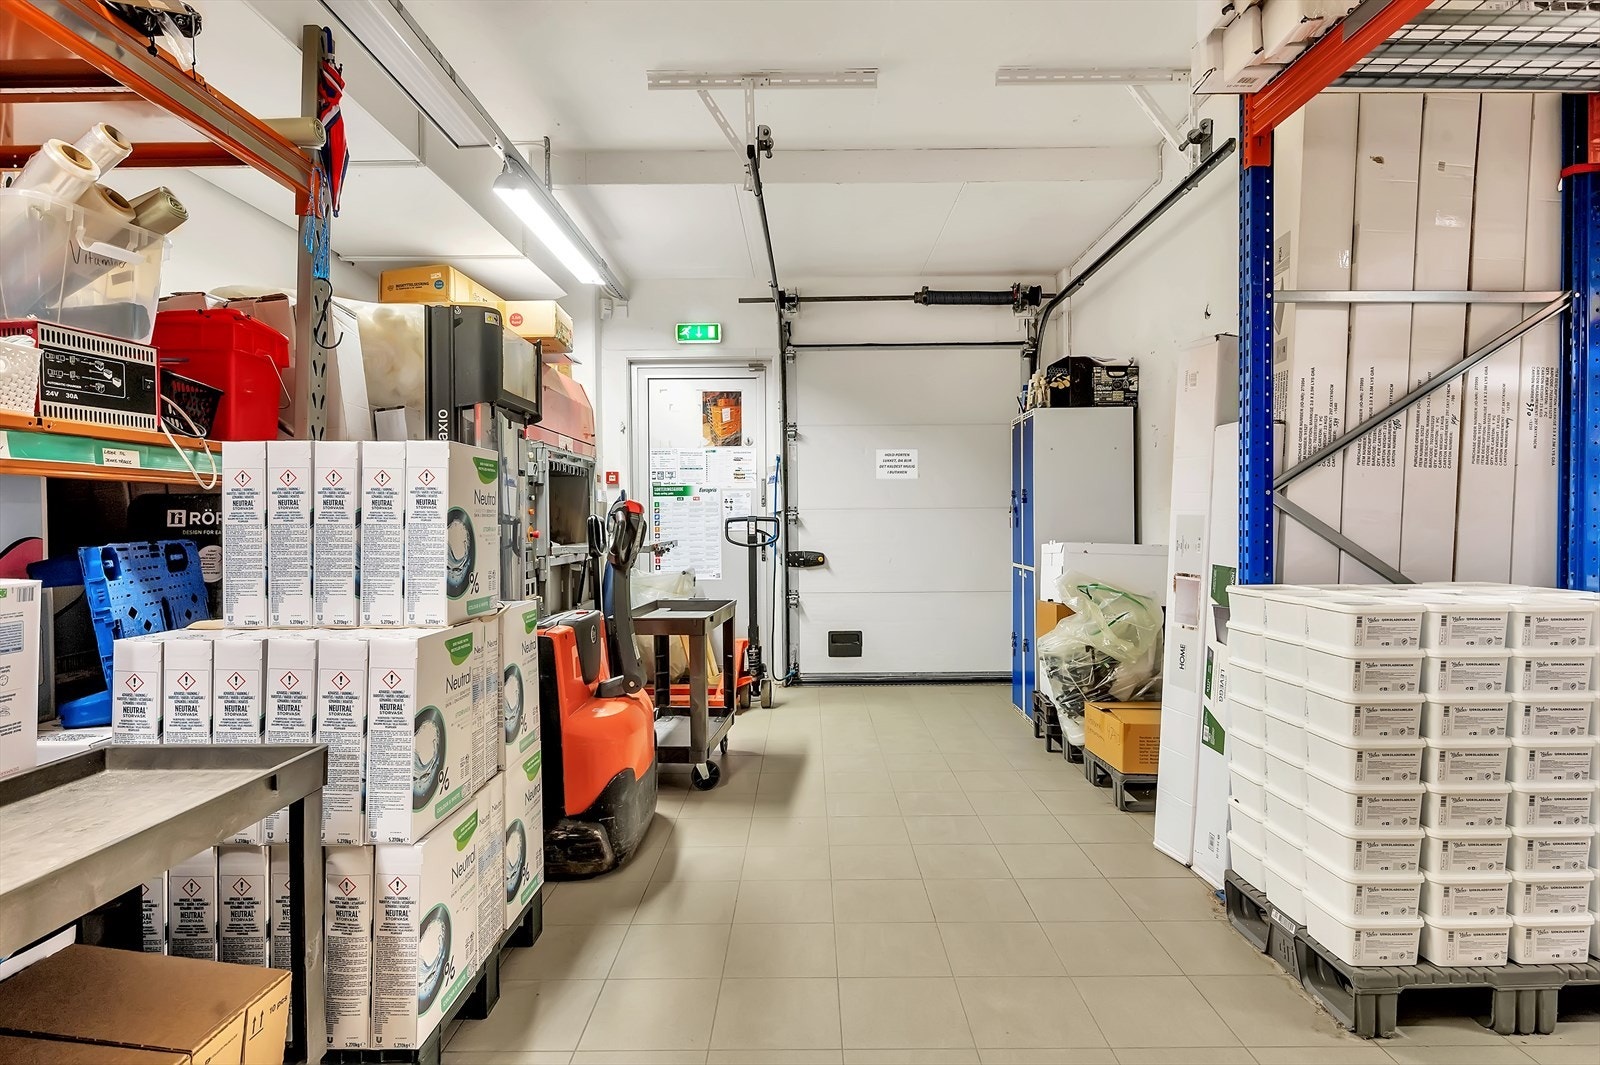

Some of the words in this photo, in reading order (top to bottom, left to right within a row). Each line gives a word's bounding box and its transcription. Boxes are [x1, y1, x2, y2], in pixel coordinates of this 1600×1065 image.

[474, 489, 497, 506] Neutral
[445, 666, 471, 694] Neutral
[1218, 669, 1226, 703] LEVEGG
[451, 844, 476, 884] Neutral
